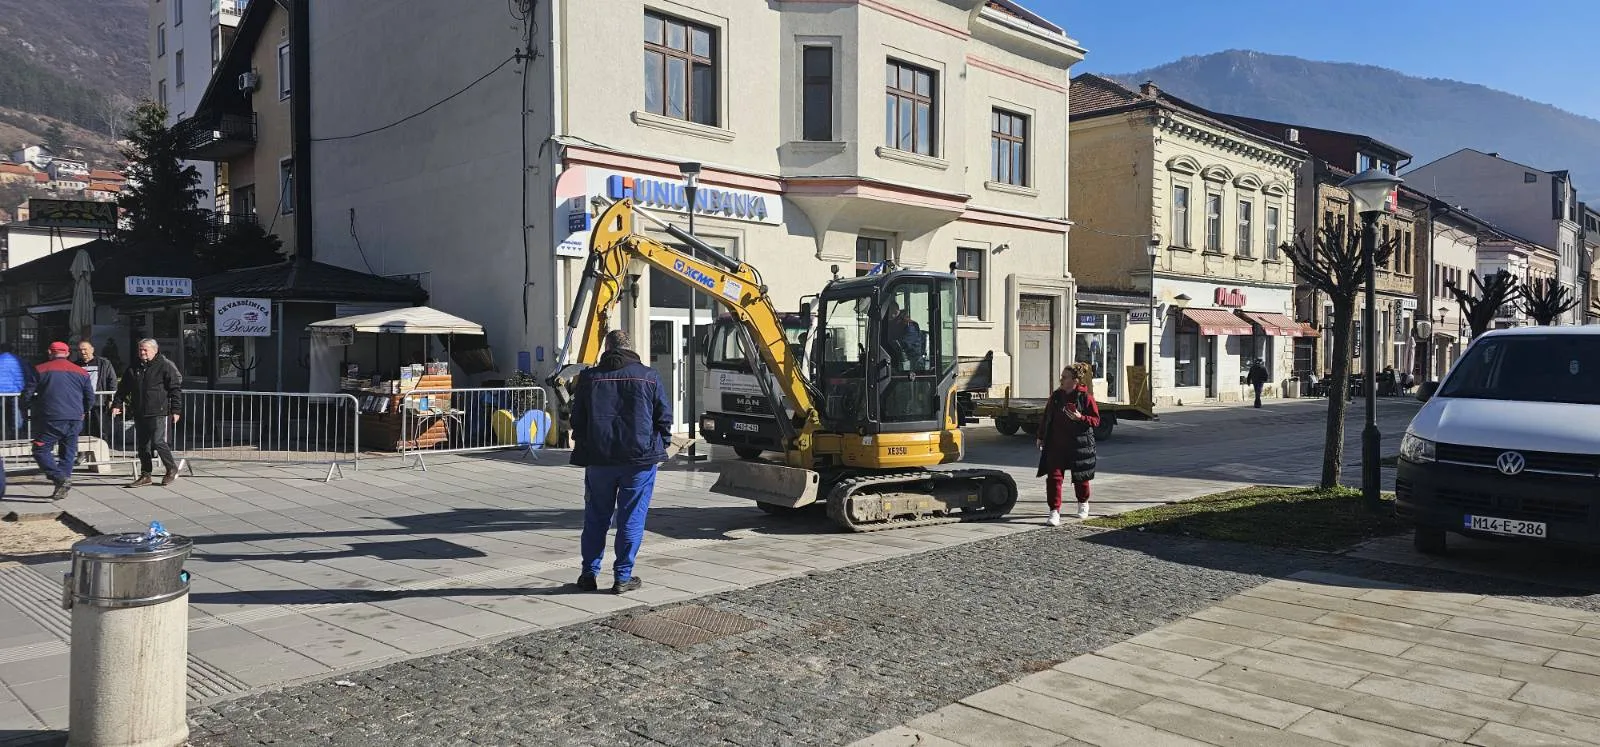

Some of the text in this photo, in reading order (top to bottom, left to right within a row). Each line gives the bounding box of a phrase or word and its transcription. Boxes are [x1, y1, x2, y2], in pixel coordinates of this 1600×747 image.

[683, 265, 715, 288] XCMG
[219, 318, 267, 333] Bosna
[736, 397, 760, 406] MAN
[887, 446, 908, 456] XE35U
[1472, 517, 1544, 535] M14-E-286
